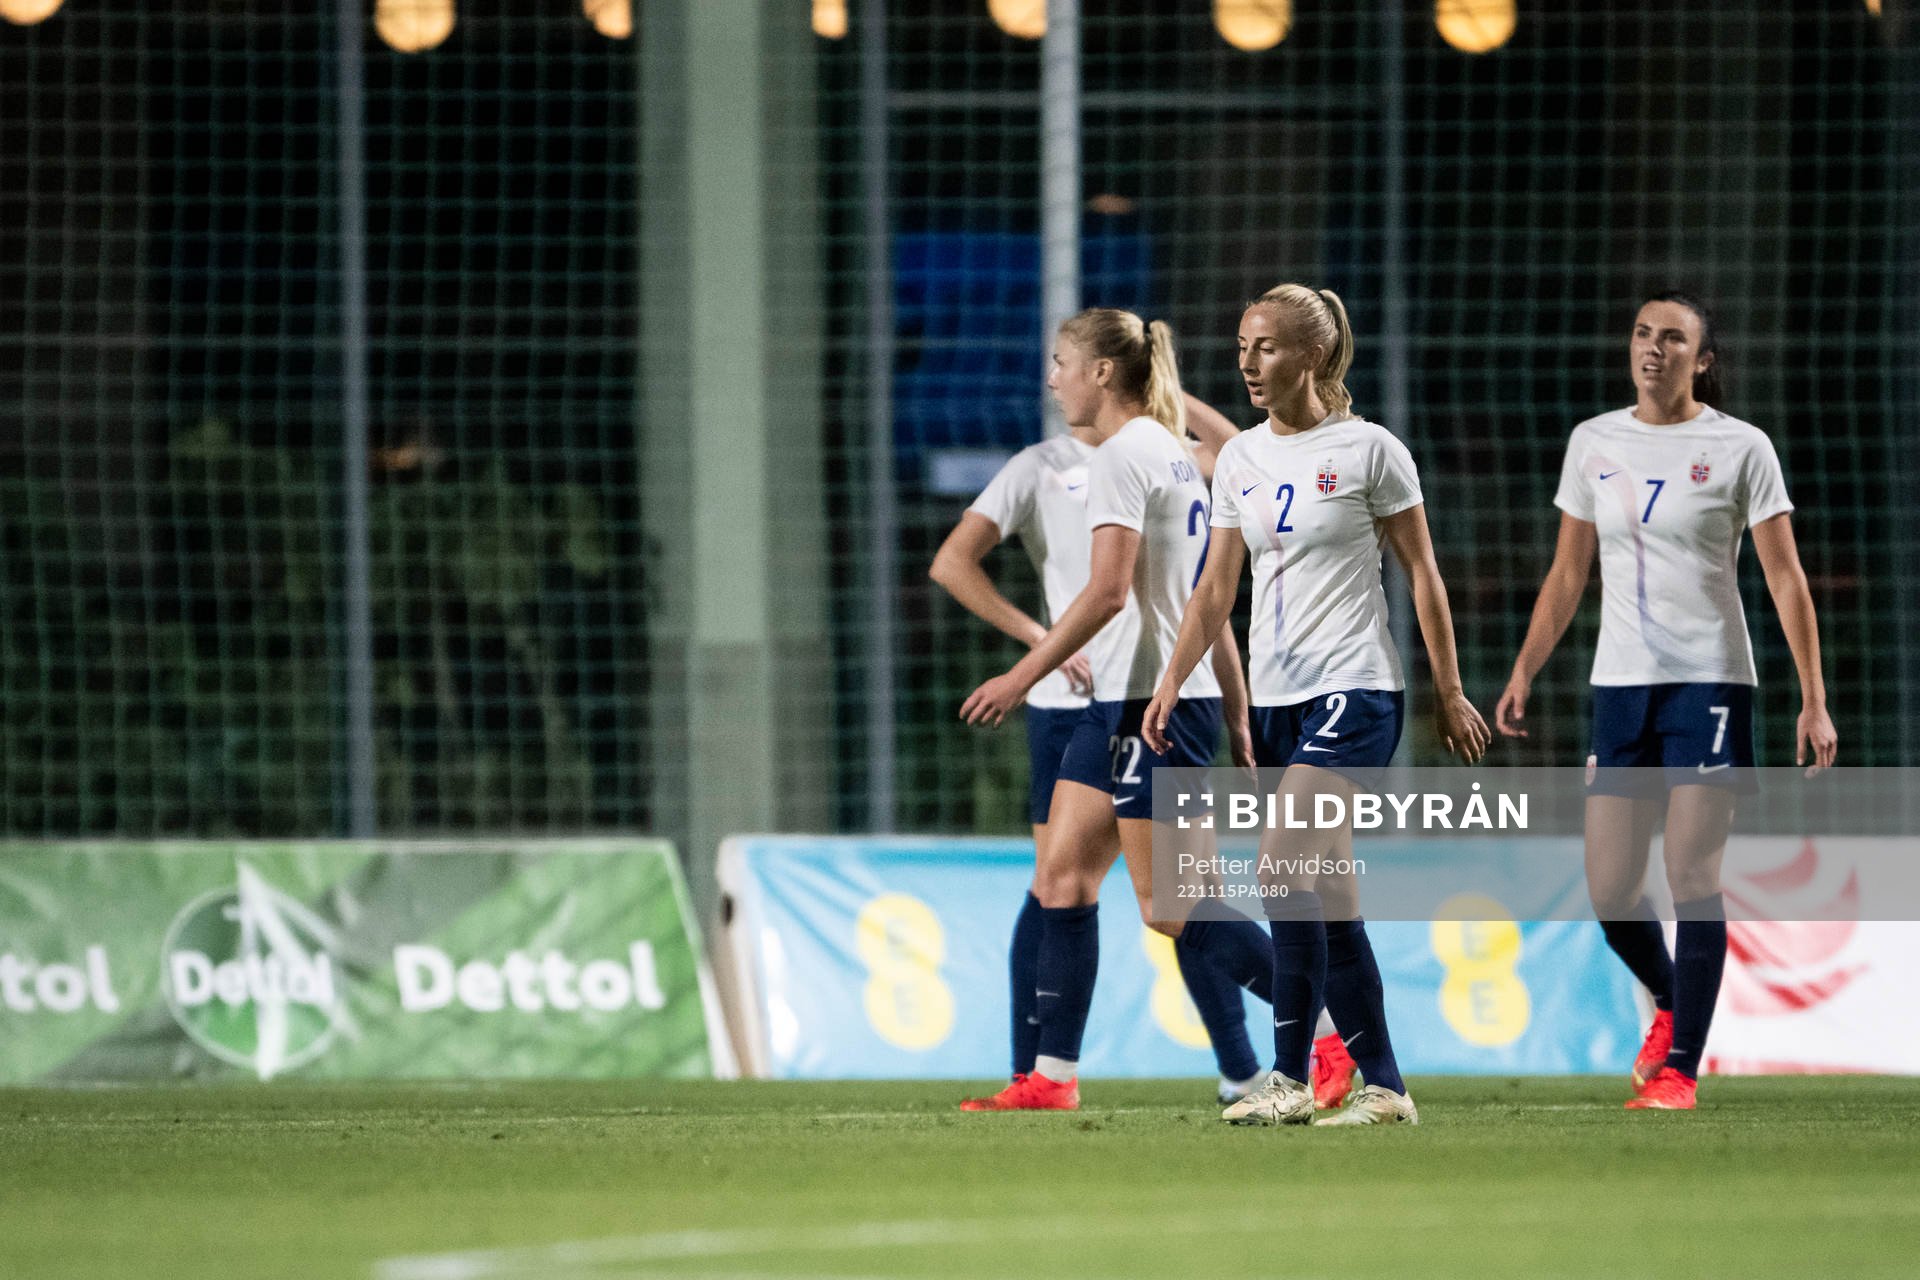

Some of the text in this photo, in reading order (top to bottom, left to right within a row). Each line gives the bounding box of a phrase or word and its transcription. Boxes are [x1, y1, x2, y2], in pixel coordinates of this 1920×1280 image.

[1275, 483, 1295, 533] 2
[1641, 479, 1666, 523] 7
[1315, 693, 1347, 738] 2
[1709, 706, 1730, 754] 7
[1108, 734, 1143, 784] 22
[393, 940, 666, 1012] Dettol
